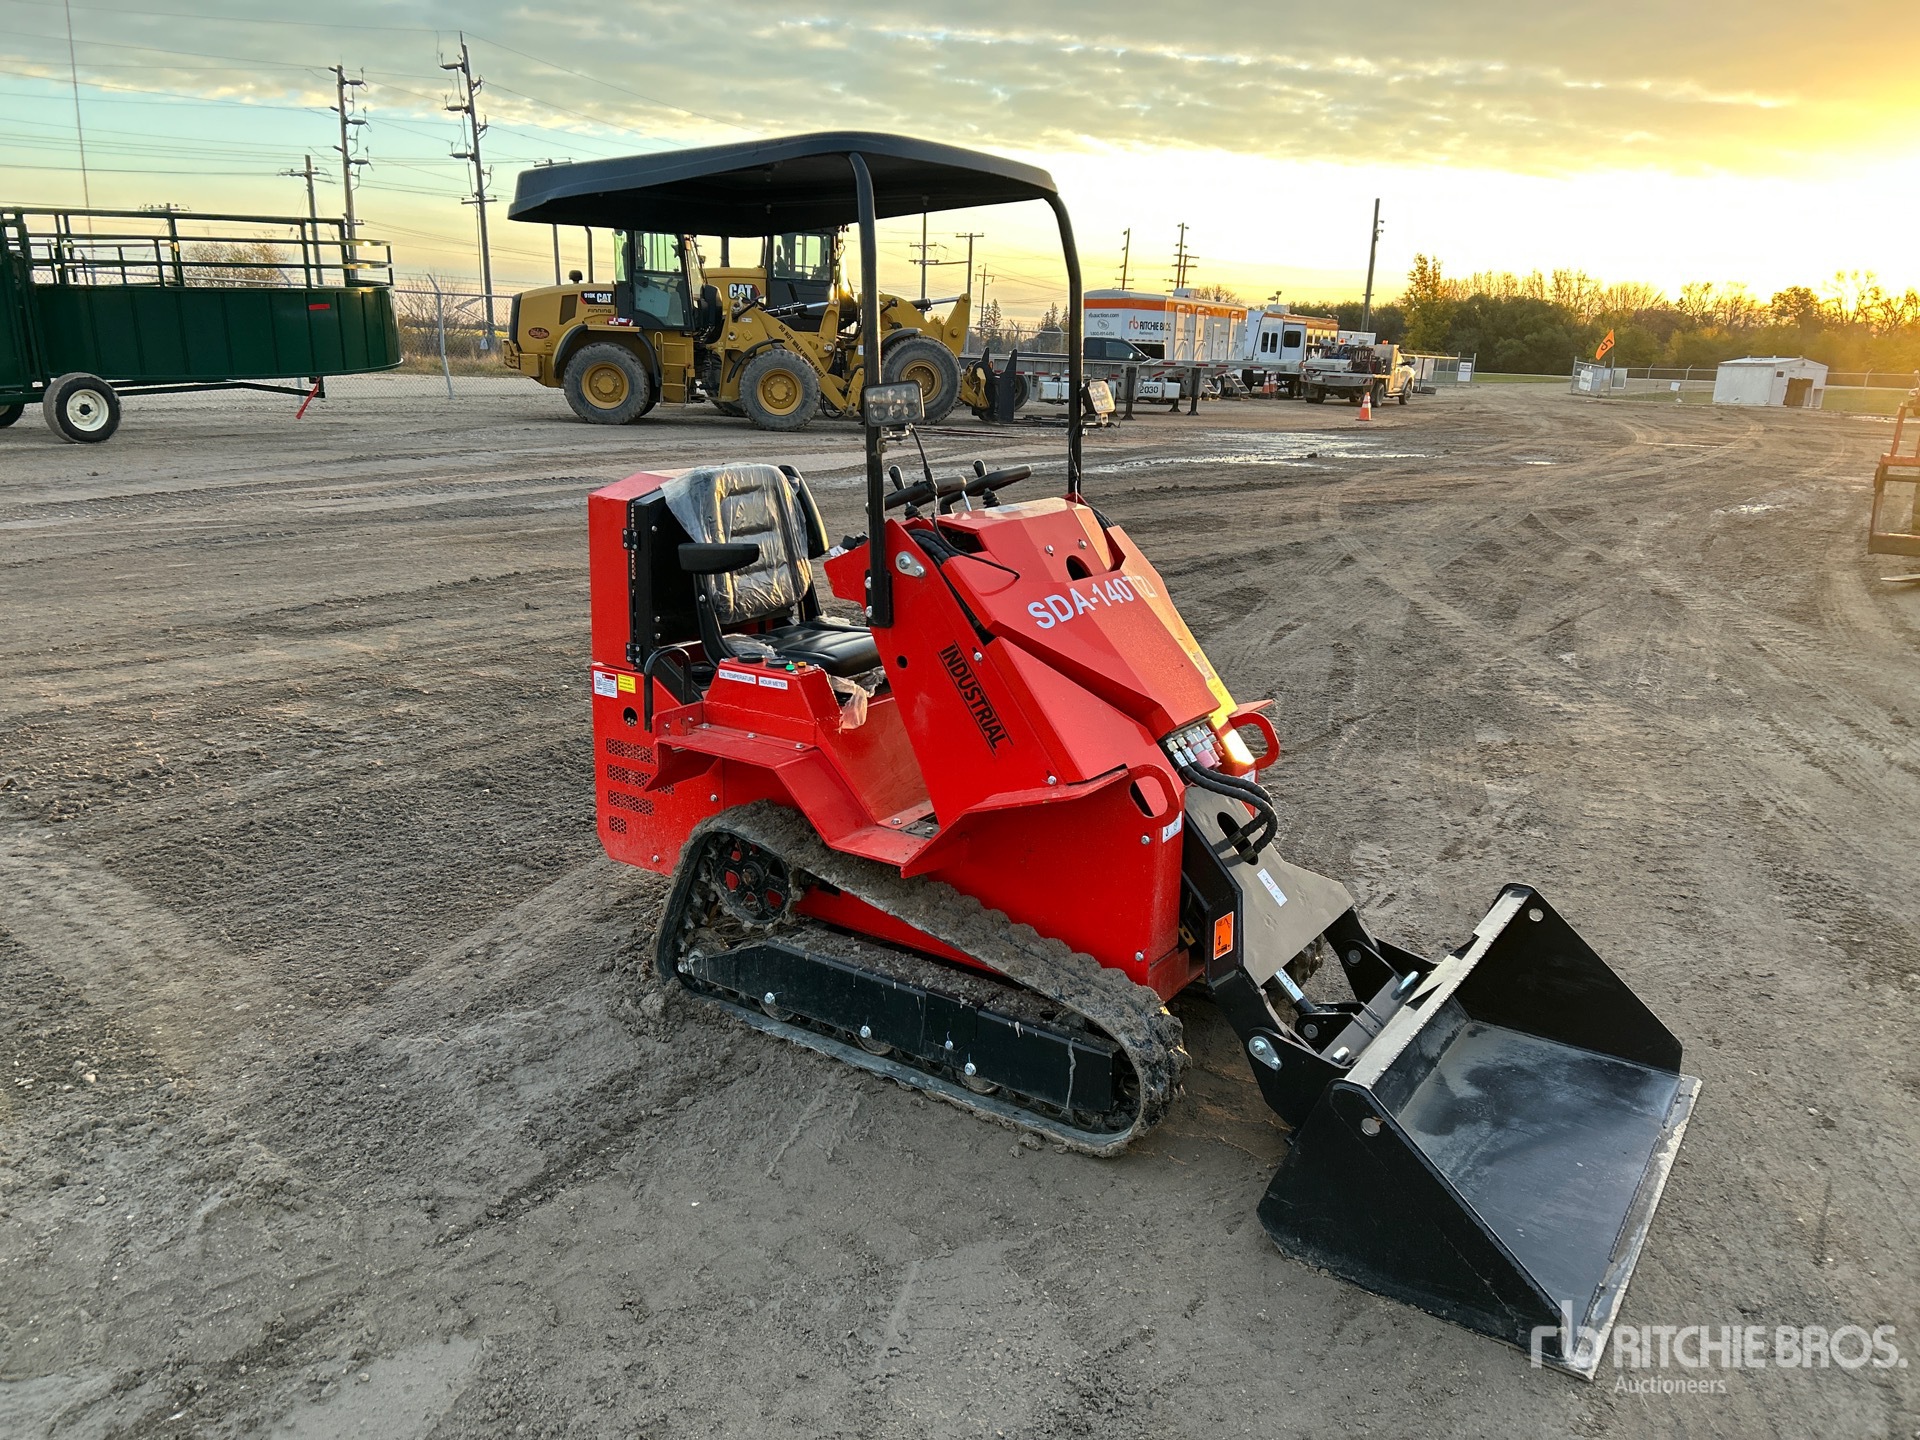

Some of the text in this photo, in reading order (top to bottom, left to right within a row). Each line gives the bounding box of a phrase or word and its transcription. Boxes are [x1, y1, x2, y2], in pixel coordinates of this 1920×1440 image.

[729, 283, 753, 300] CAT
[596, 293, 612, 303] CAT
[1139, 321, 1159, 331] RITCHIE
[778, 324, 786, 333] DO
[784, 332, 794, 341] NOT
[792, 340, 804, 353] WALK
[802, 352, 815, 366] UNDER
[1139, 386, 1159, 394] 2030
[726, 672, 755, 683] TEMPERATURE
[760, 678, 787, 688] HOUR METER
[940, 644, 1007, 750] INDUSTRIAL
